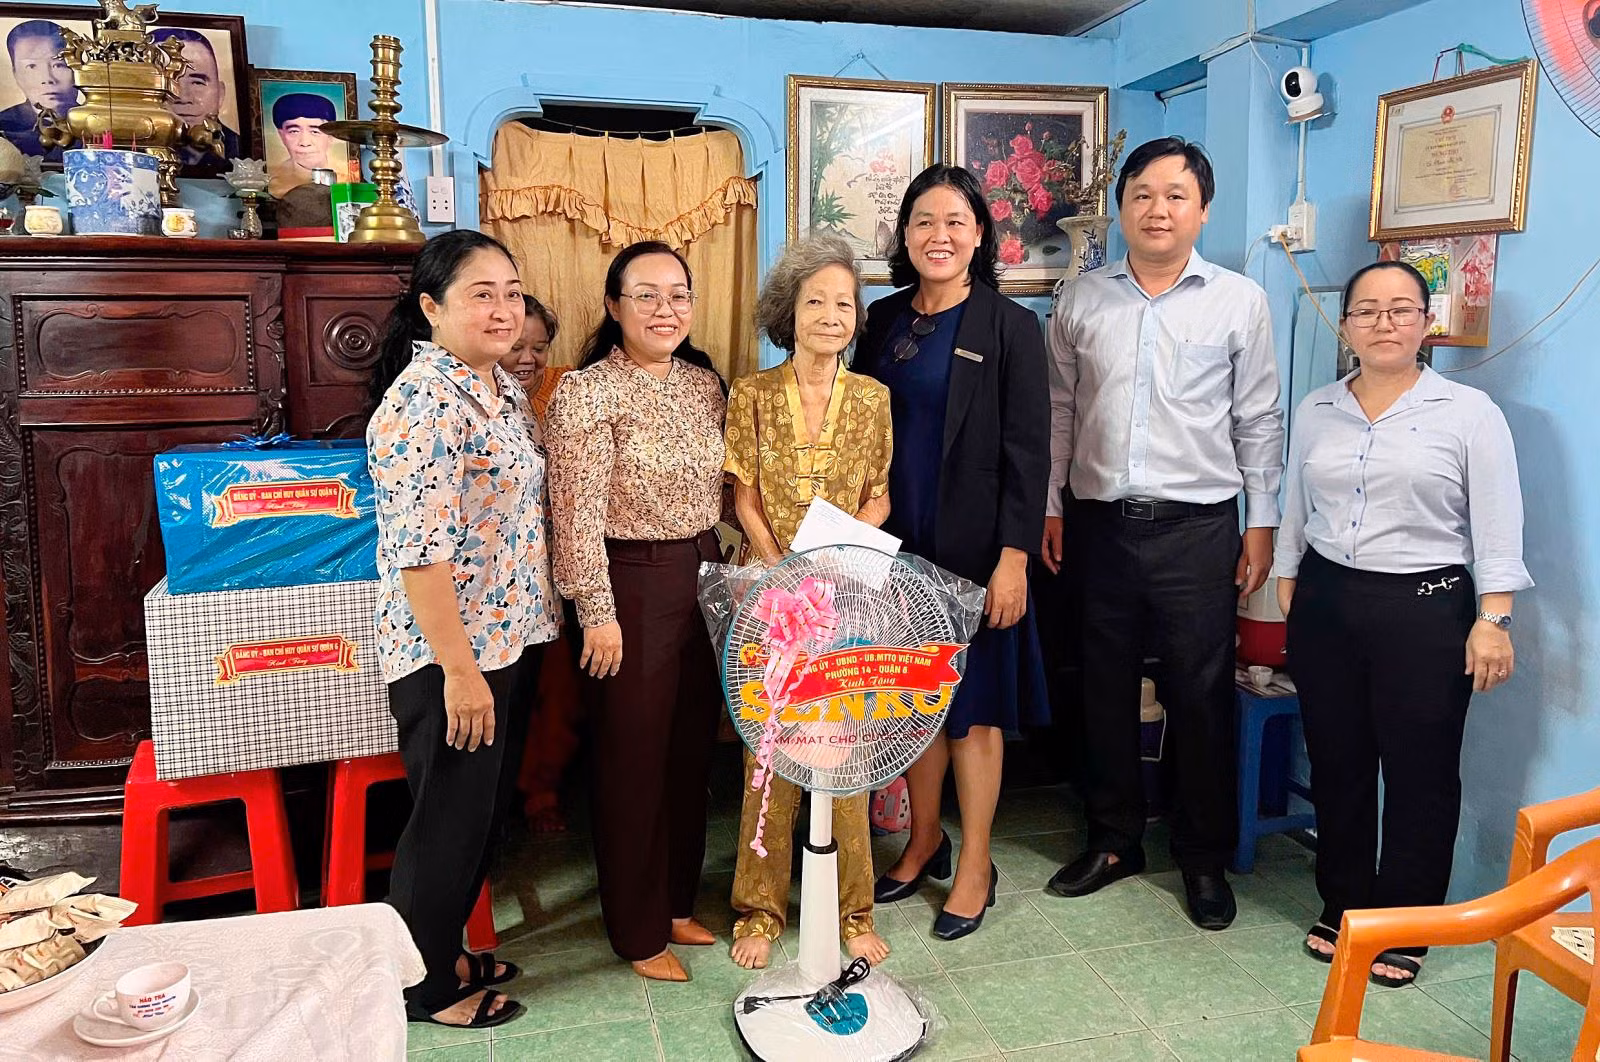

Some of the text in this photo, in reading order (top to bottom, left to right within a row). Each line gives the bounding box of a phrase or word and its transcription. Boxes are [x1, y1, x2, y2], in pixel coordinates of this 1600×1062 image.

[795, 663, 818, 676] ĐNG
[836, 655, 858, 666] UBND
[898, 654, 913, 664] VIỆT
[914, 657, 932, 666] NAM
[862, 666, 871, 674] 14
[879, 666, 901, 675] QUẬN
[829, 735, 857, 744] CHO
